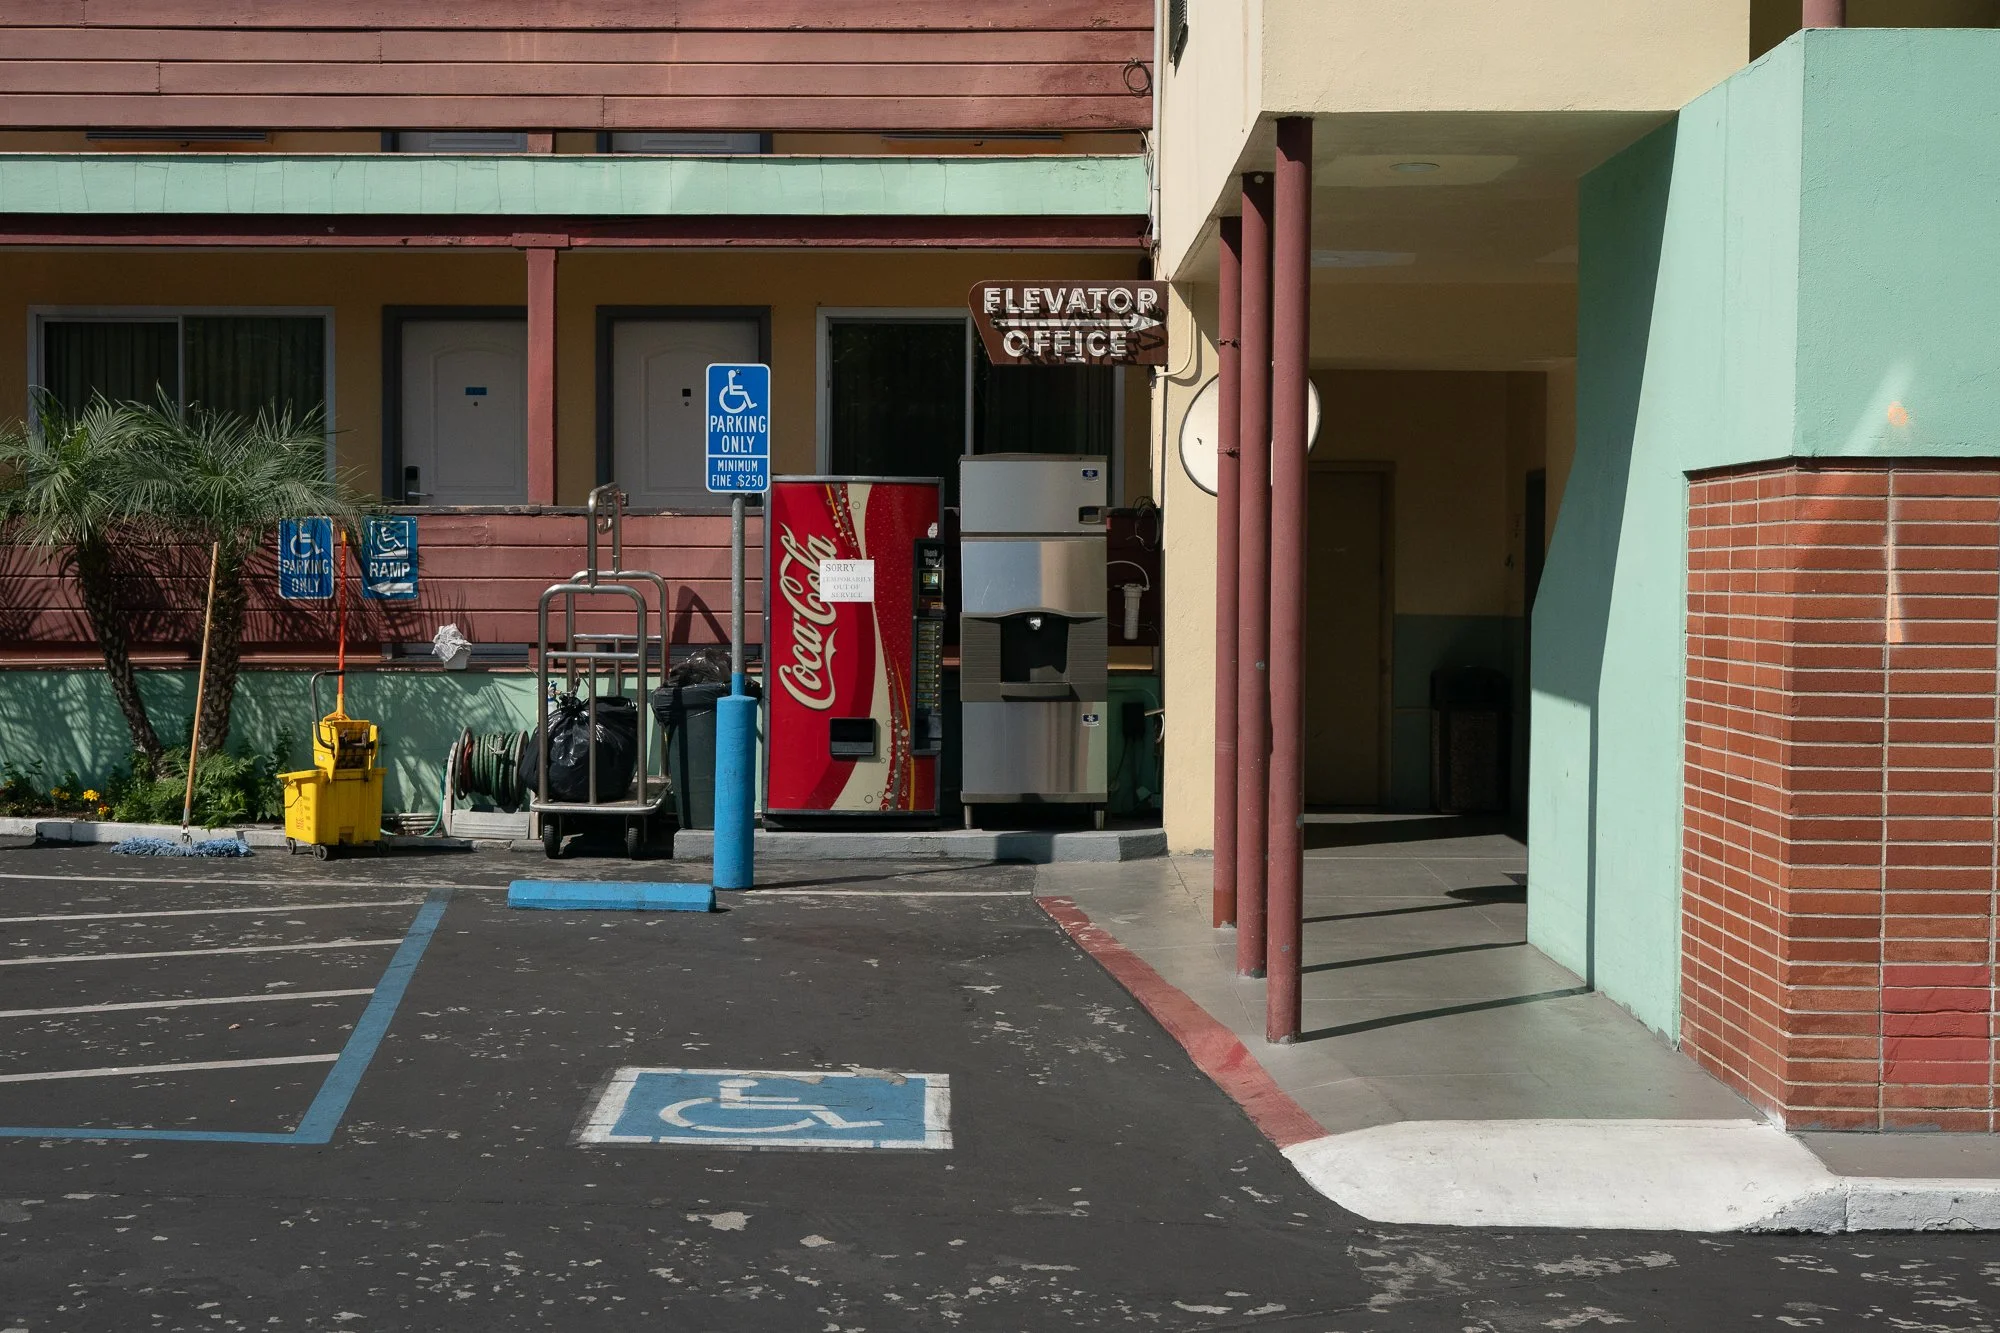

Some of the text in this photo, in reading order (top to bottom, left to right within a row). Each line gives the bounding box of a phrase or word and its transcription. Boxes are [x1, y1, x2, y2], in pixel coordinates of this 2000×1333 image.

[983, 287, 1158, 314] ELEVATOR
[1003, 329, 1128, 357] OFFICE
[710, 415, 767, 434] PARKING
[721, 435, 755, 453] ONLY
[717, 460, 758, 472] MINIMUM
[711, 474, 764, 487] FINE $250
[282, 559, 329, 575] PARKING
[369, 562, 411, 578] RAMP
[825, 563, 856, 572] SORRY
[291, 577, 321, 593] ONLY
